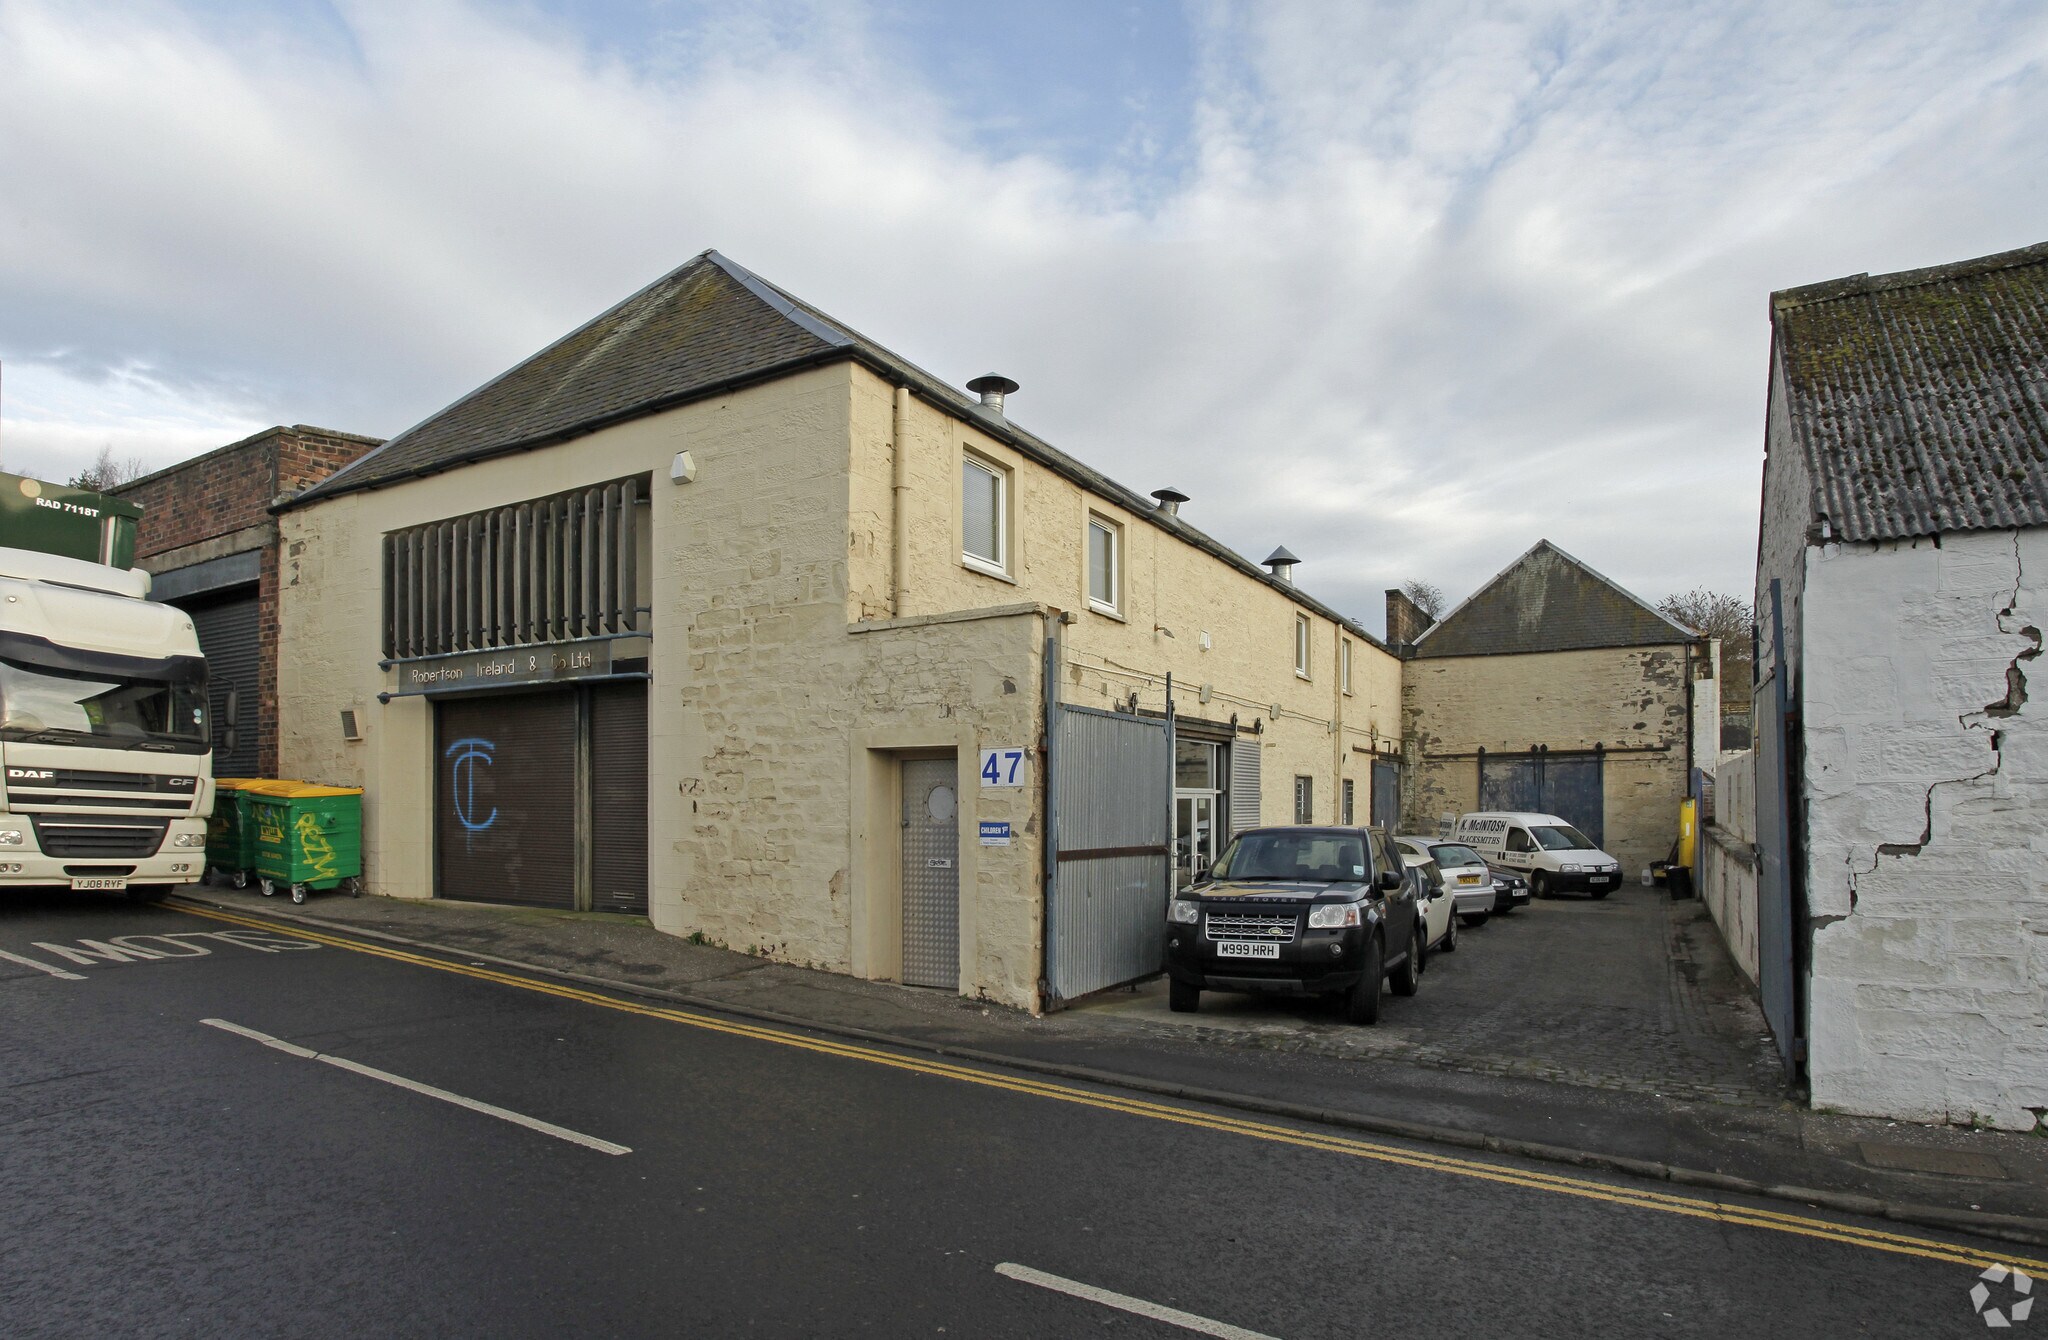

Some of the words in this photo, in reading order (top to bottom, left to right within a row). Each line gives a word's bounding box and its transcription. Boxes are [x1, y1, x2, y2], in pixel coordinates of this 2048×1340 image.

[36, 498, 61, 509] RAD
[64, 503, 99, 517] 7118T
[412, 666, 463, 684] Robertson
[476, 659, 515, 677] Ireland
[529, 655, 537, 672] &
[571, 651, 592, 669] Ltd
[9, 769, 54, 779] DAF
[982, 752, 1022, 784] 47
[169, 778, 194, 786] CF
[1460, 819, 1467, 830] K.
[1469, 819, 1507, 832] McINTOSH
[1458, 835, 1501, 844] BLACKSMITHS
[77, 879, 102, 888] YJ08
[104, 879, 123, 888] RYF
[1222, 944, 1250, 955] M999
[1252, 945, 1275, 956] HRH
